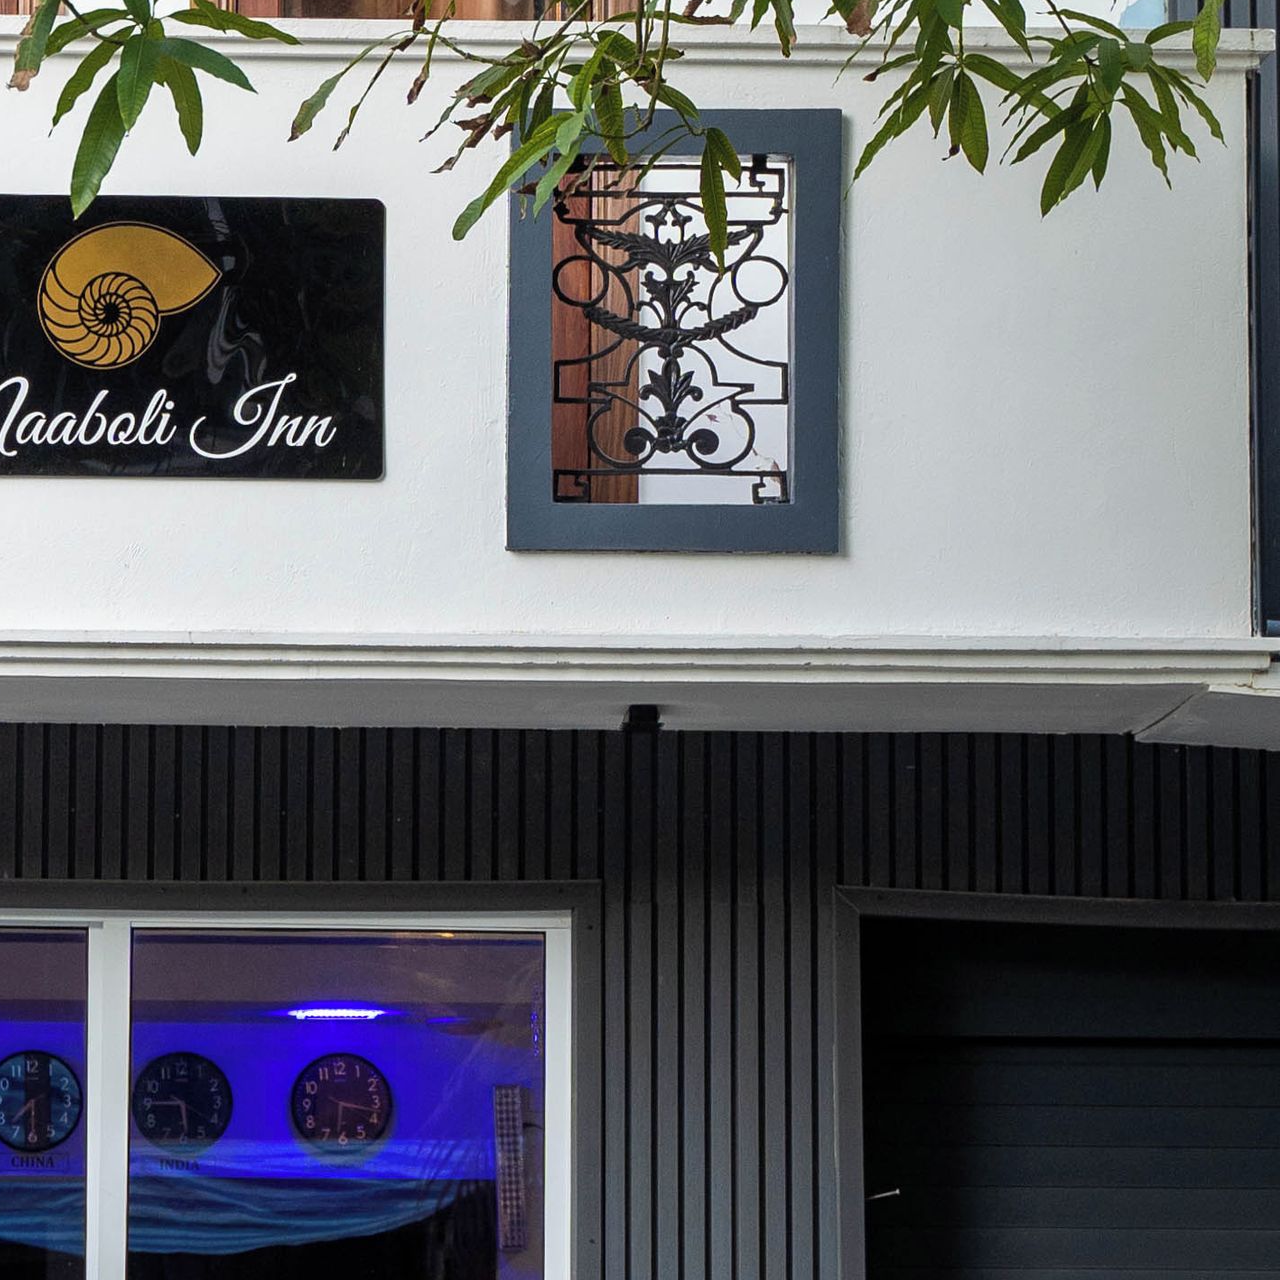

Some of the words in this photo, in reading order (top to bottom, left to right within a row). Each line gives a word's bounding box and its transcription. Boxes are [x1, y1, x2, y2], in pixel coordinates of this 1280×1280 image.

[189, 373, 338, 460] Inn
[11, 1064, 22, 1078] 11
[26, 1060, 39, 1073] 12
[161, 1067, 171, 1080] 11
[334, 1062, 347, 1075] 12
[319, 1067, 329, 1081] 11
[60, 1076, 70, 1091] 2
[209, 1077, 219, 1092] 2
[305, 1081, 318, 1095] 10
[368, 1078, 377, 1092] 2
[63, 1094, 72, 1108] 3
[143, 1097, 152, 1111] 9
[213, 1095, 221, 1109] 3
[302, 1098, 312, 1112] 9
[372, 1095, 380, 1109] 3
[59, 1111, 68, 1125] 4
[146, 1114, 156, 1128] 8
[210, 1114, 218, 1124] 4
[306, 1115, 316, 1129] 8
[369, 1112, 378, 1124] 4
[12, 1125, 20, 1140] 7
[27, 1129, 38, 1143] 6
[46, 1125, 56, 1138] 5
[179, 1132, 188, 1144] 6
[197, 1126, 206, 1139] 5
[321, 1128, 331, 1141] 7
[338, 1132, 348, 1145] 6
[356, 1125, 366, 1139] 5
[11, 1155, 55, 1168] CHINA
[159, 1159, 200, 1171] INDIA
